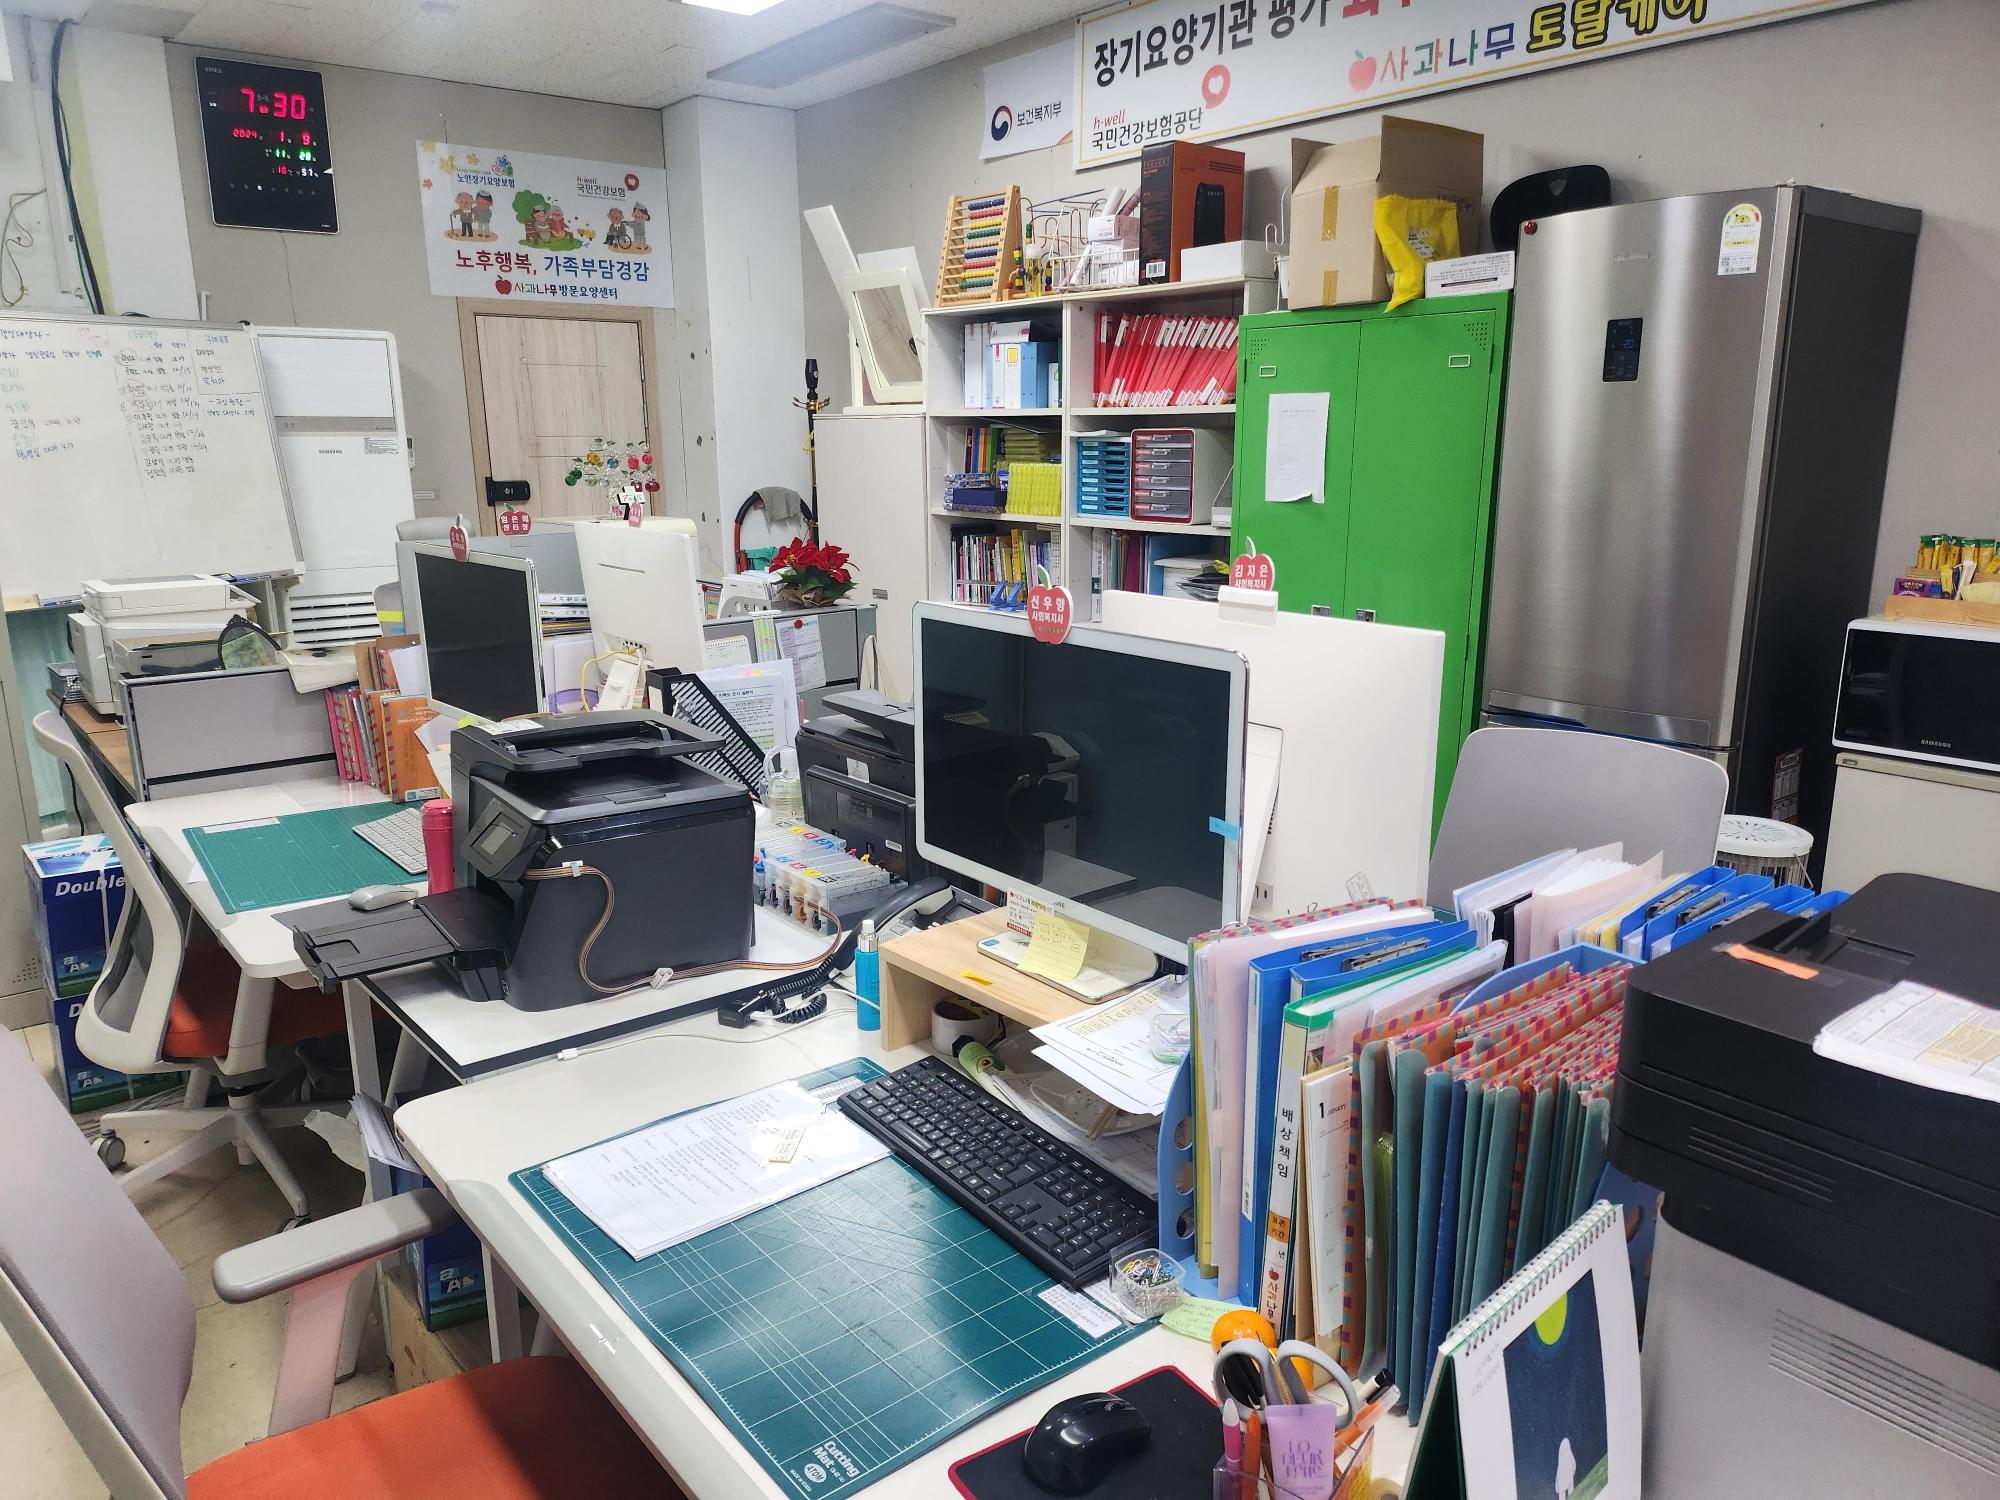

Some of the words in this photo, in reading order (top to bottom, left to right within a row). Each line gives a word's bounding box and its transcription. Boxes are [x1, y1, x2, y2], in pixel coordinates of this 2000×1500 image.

[1094, 1, 1257, 88] 장기요양기관
[1379, 22, 1515, 82] 사과나무
[1016, 100, 1062, 127] 보건복지부
[232, 128, 258, 140] 2024
[1091, 107, 1203, 151] 국민건강보험공단
[457, 174, 515, 188] 노인장기요양보험
[577, 183, 626, 197] 국민건강보험
[456, 250, 537, 276] 노후행복,
[544, 256, 650, 282] 가족부담경감
[1920, 739, 1951, 748] SAMSUNG
[55, 873, 126, 896] Double
[1319, 1102, 1325, 1118] 1
[1328, 1104, 1347, 1116] January
[812, 1446, 835, 1469] Mat
[823, 1441, 860, 1478] Cutting
[807, 1465, 824, 1480] ATOM
